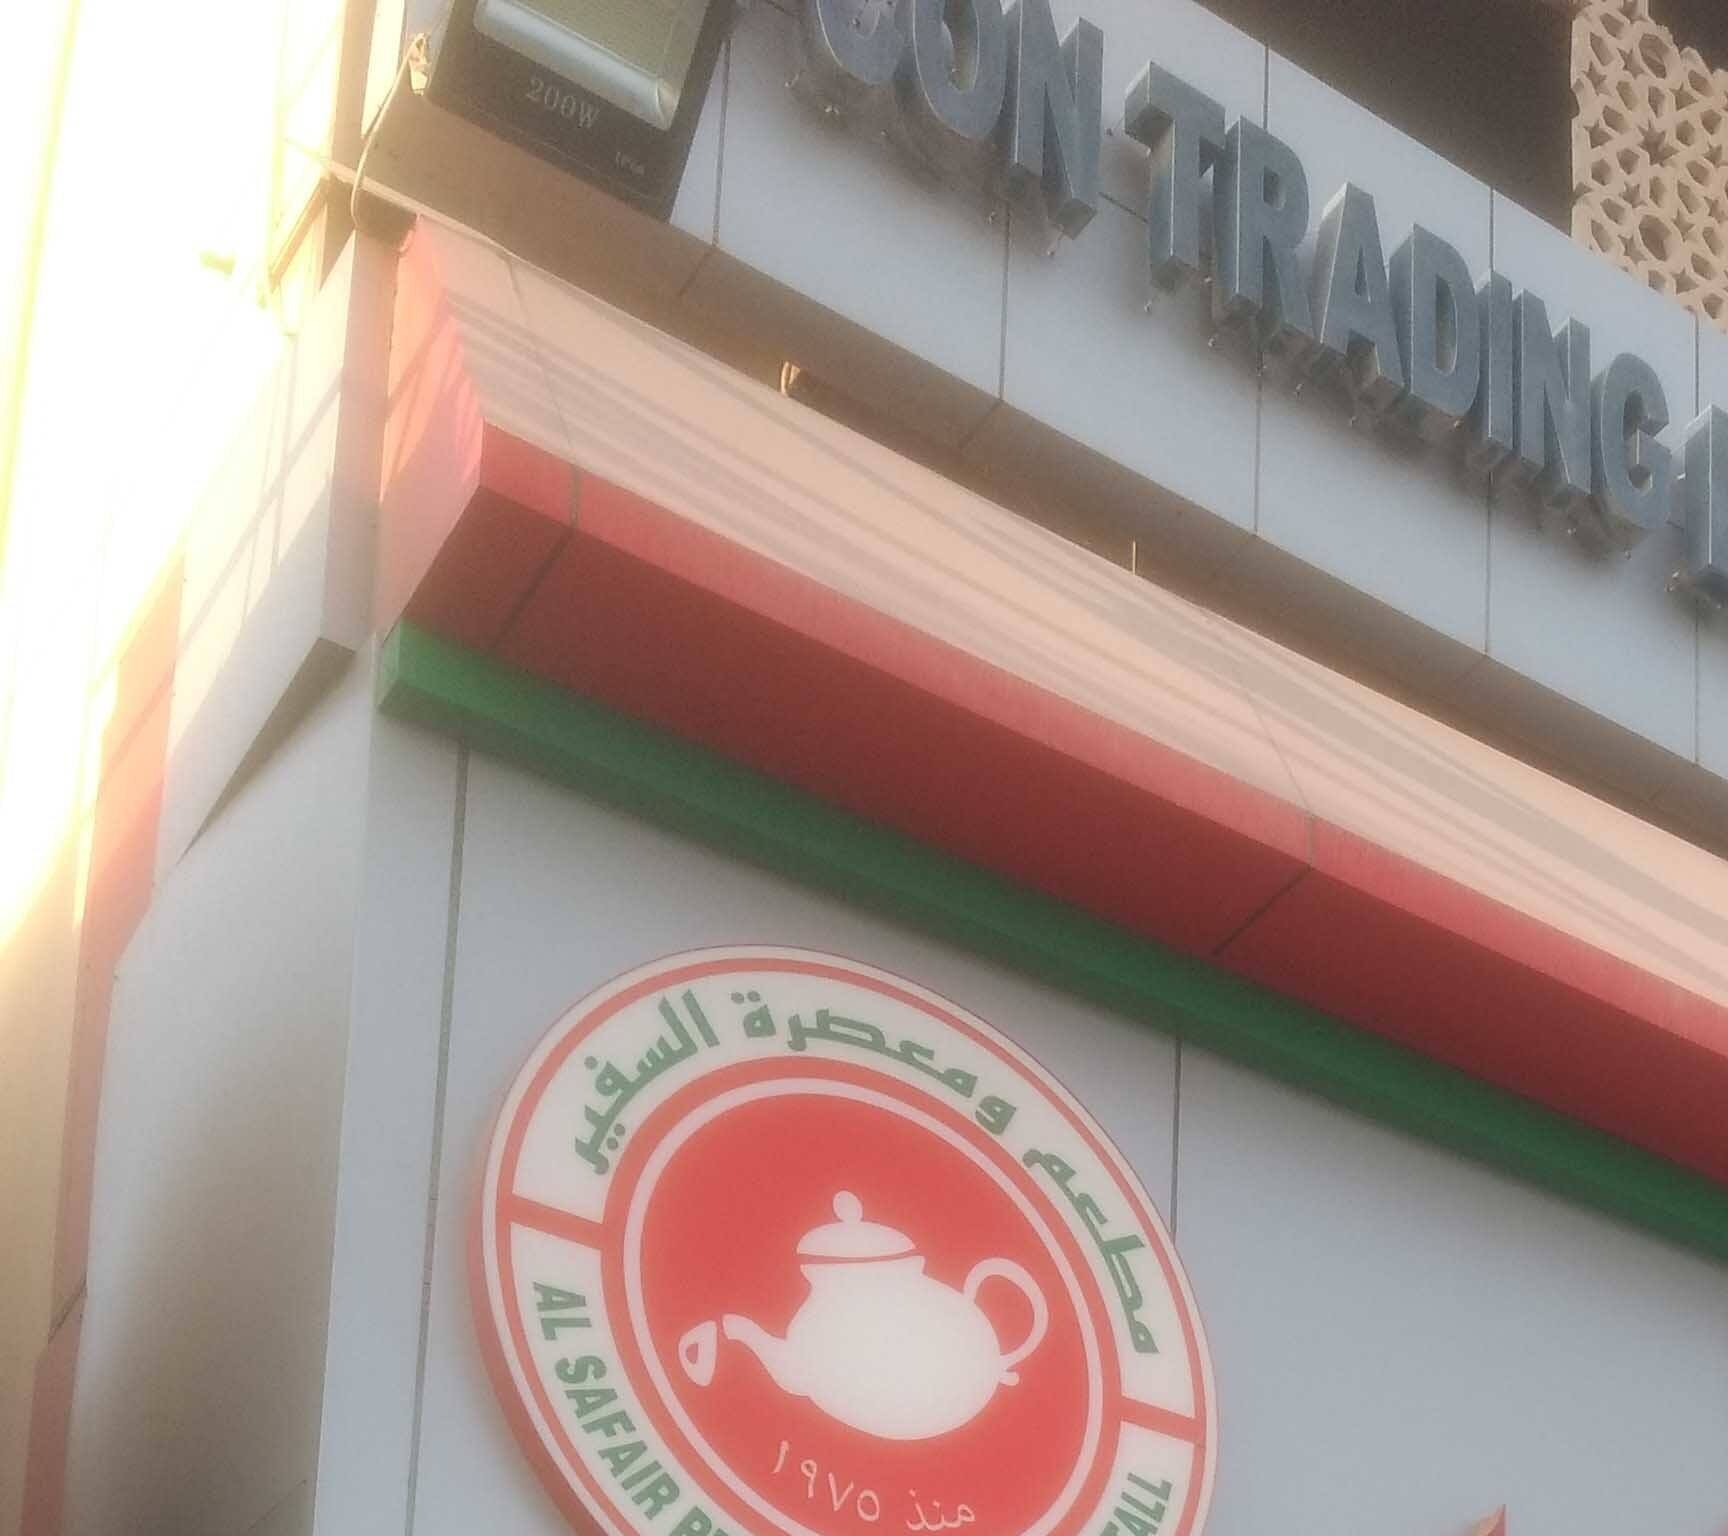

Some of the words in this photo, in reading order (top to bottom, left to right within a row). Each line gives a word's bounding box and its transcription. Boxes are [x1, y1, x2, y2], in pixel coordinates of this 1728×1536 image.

[526, 76, 600, 129] 200W
[1124, 60, 1671, 532] TRADING
[573, 988, 720, 1176] السفير
[729, 987, 1018, 1137] ومعصرة
[532, 1280, 592, 1342] AL
[1022, 1146, 1160, 1357] مطعم
[554, 1354, 682, 1522] SAFAIR
[904, 1481, 977, 1533] منذ
